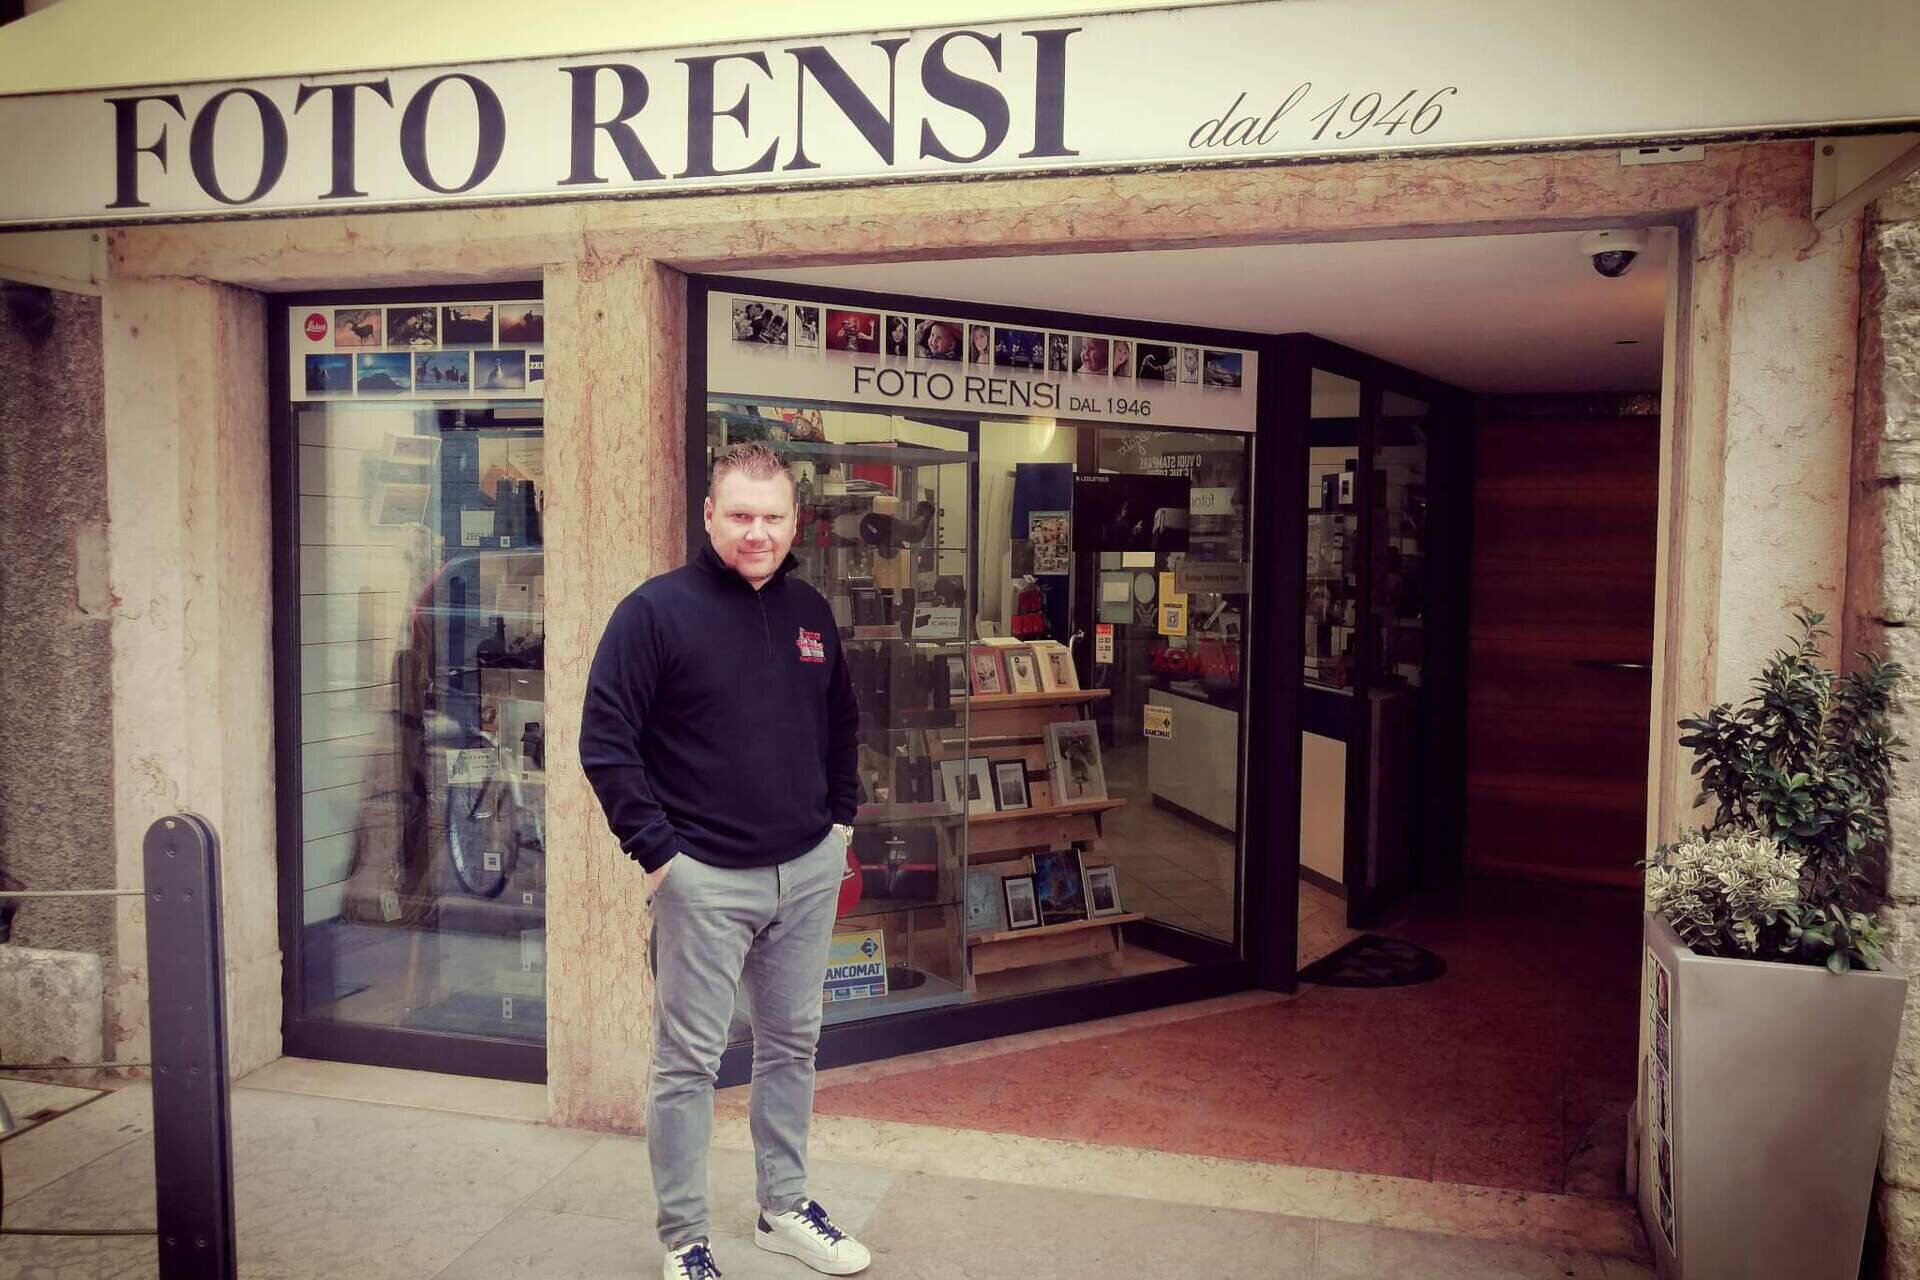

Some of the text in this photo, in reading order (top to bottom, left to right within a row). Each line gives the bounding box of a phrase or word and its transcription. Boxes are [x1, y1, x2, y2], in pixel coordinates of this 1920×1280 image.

[103, 27, 1083, 209] FOTO RENSI
[1188, 82, 1457, 149] dal 1946
[529, 361, 544, 370] ZEI
[853, 366, 1151, 416] FOTO RENSI DAL 1946
[825, 963, 882, 981] ANCOMAT
